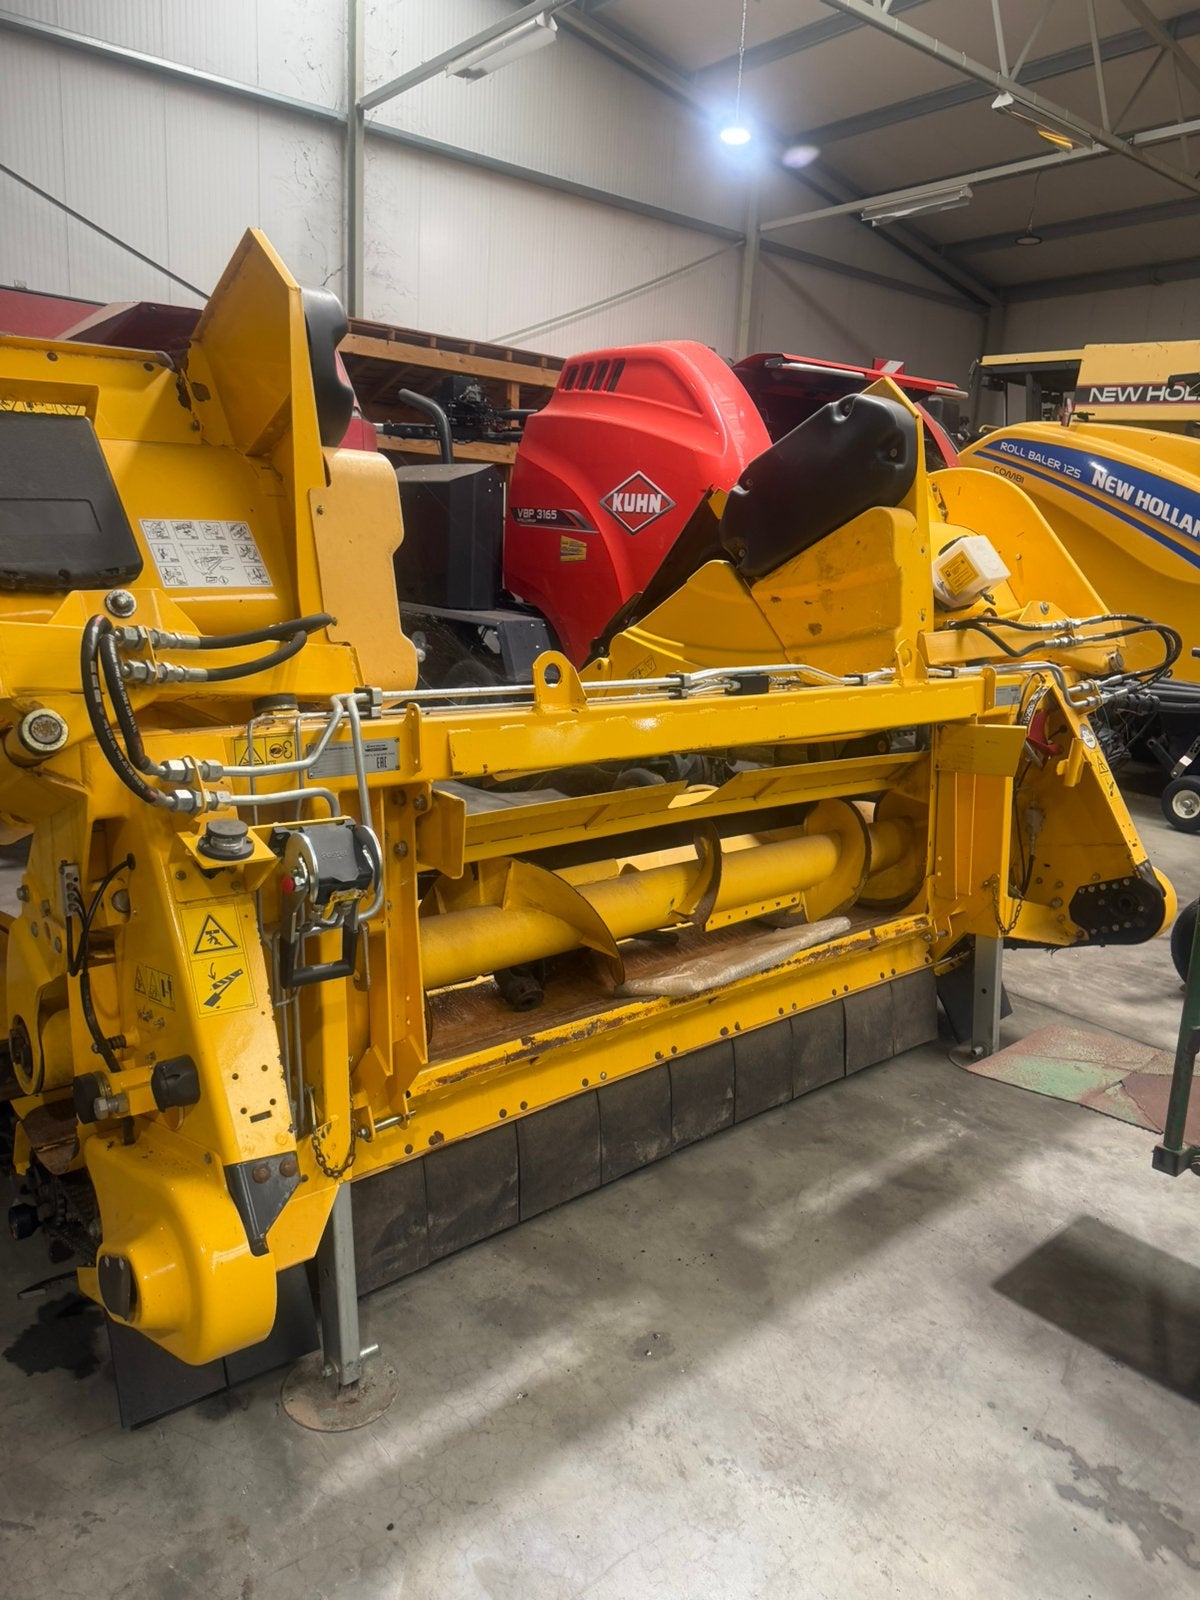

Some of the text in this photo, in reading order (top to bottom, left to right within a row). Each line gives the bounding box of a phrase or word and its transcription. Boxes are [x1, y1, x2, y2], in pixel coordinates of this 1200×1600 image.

[1089, 385, 1200, 402] NEW HOL
[1000, 442, 1082, 479] ROLL BALER 125
[993, 465, 1025, 484] COMBI
[1091, 467, 1135, 501] NEW
[612, 493, 662, 514] KUHN
[517, 508, 557, 520] VBP 3165
